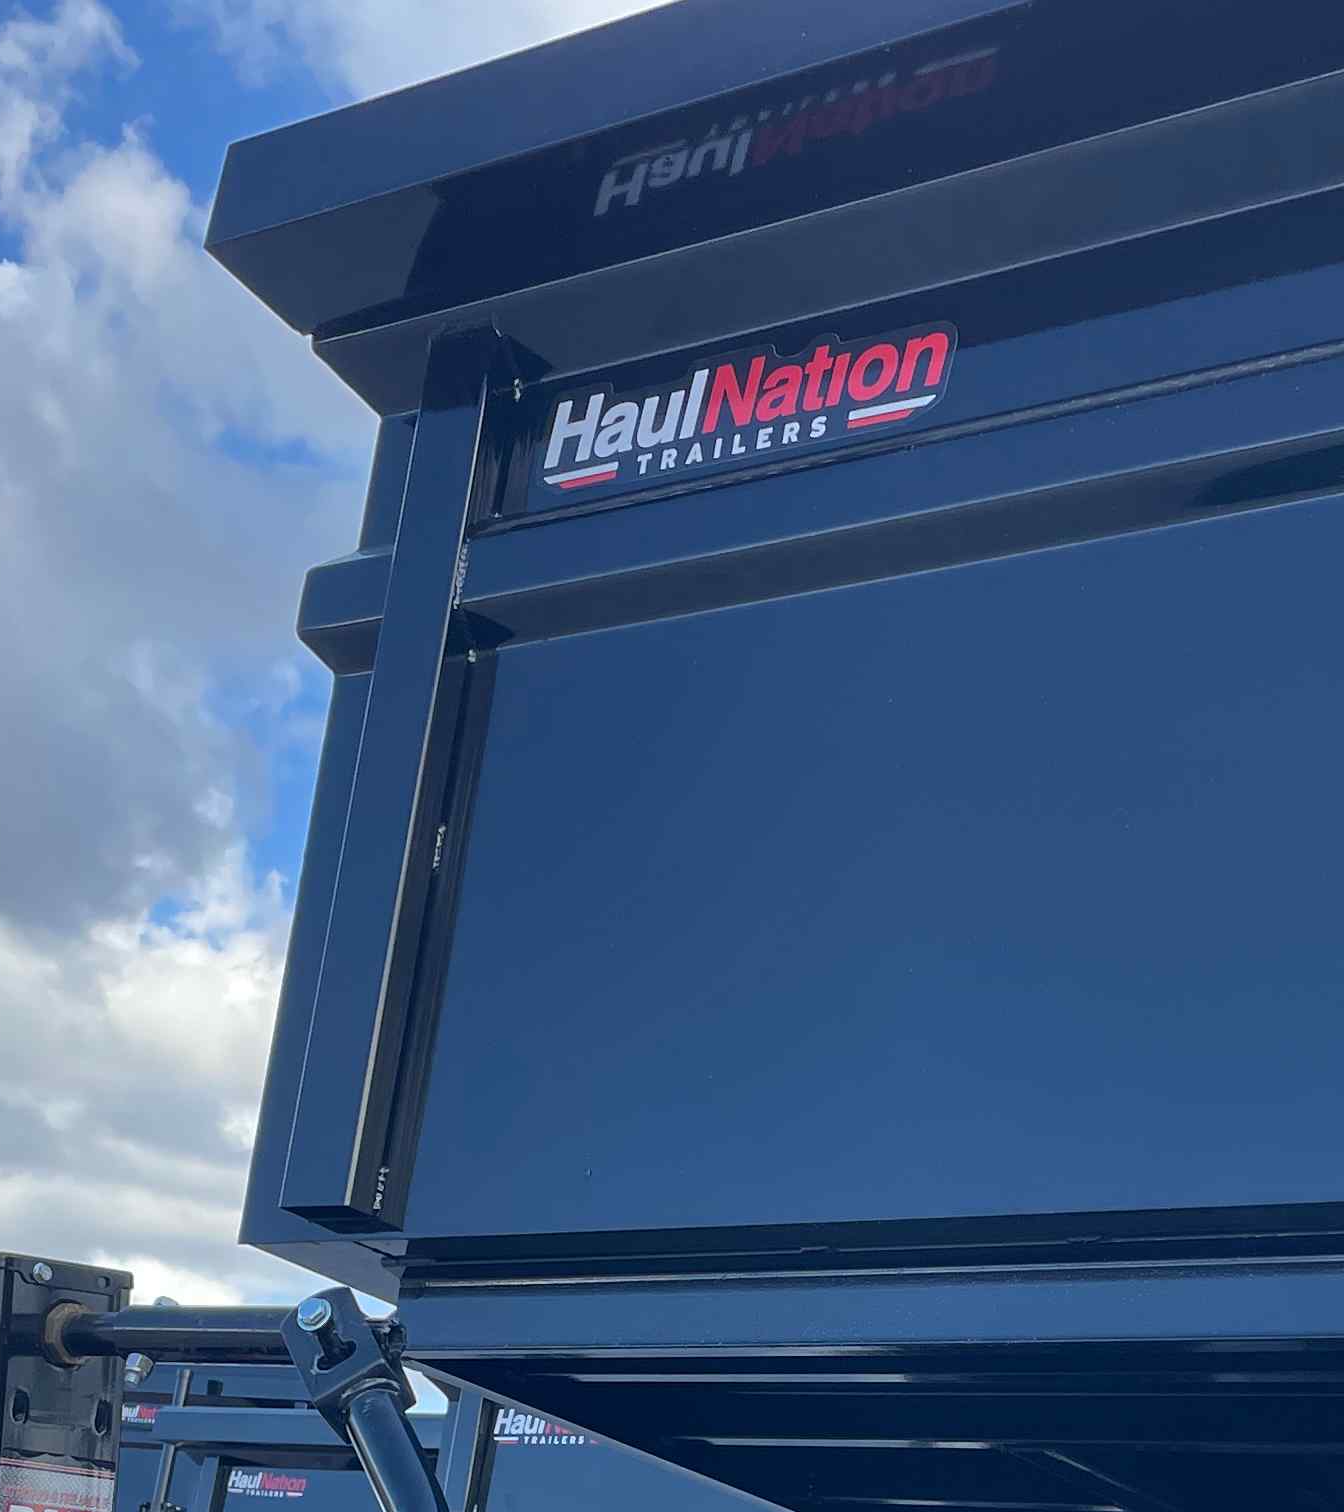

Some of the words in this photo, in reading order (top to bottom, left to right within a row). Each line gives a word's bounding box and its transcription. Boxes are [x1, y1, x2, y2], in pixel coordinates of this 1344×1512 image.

[543, 331, 949, 469] HaulNation
[637, 415, 828, 475] TRAILERS
[523, 1435, 585, 1445] TRAILERS
[228, 1470, 306, 1491] HaulNation
